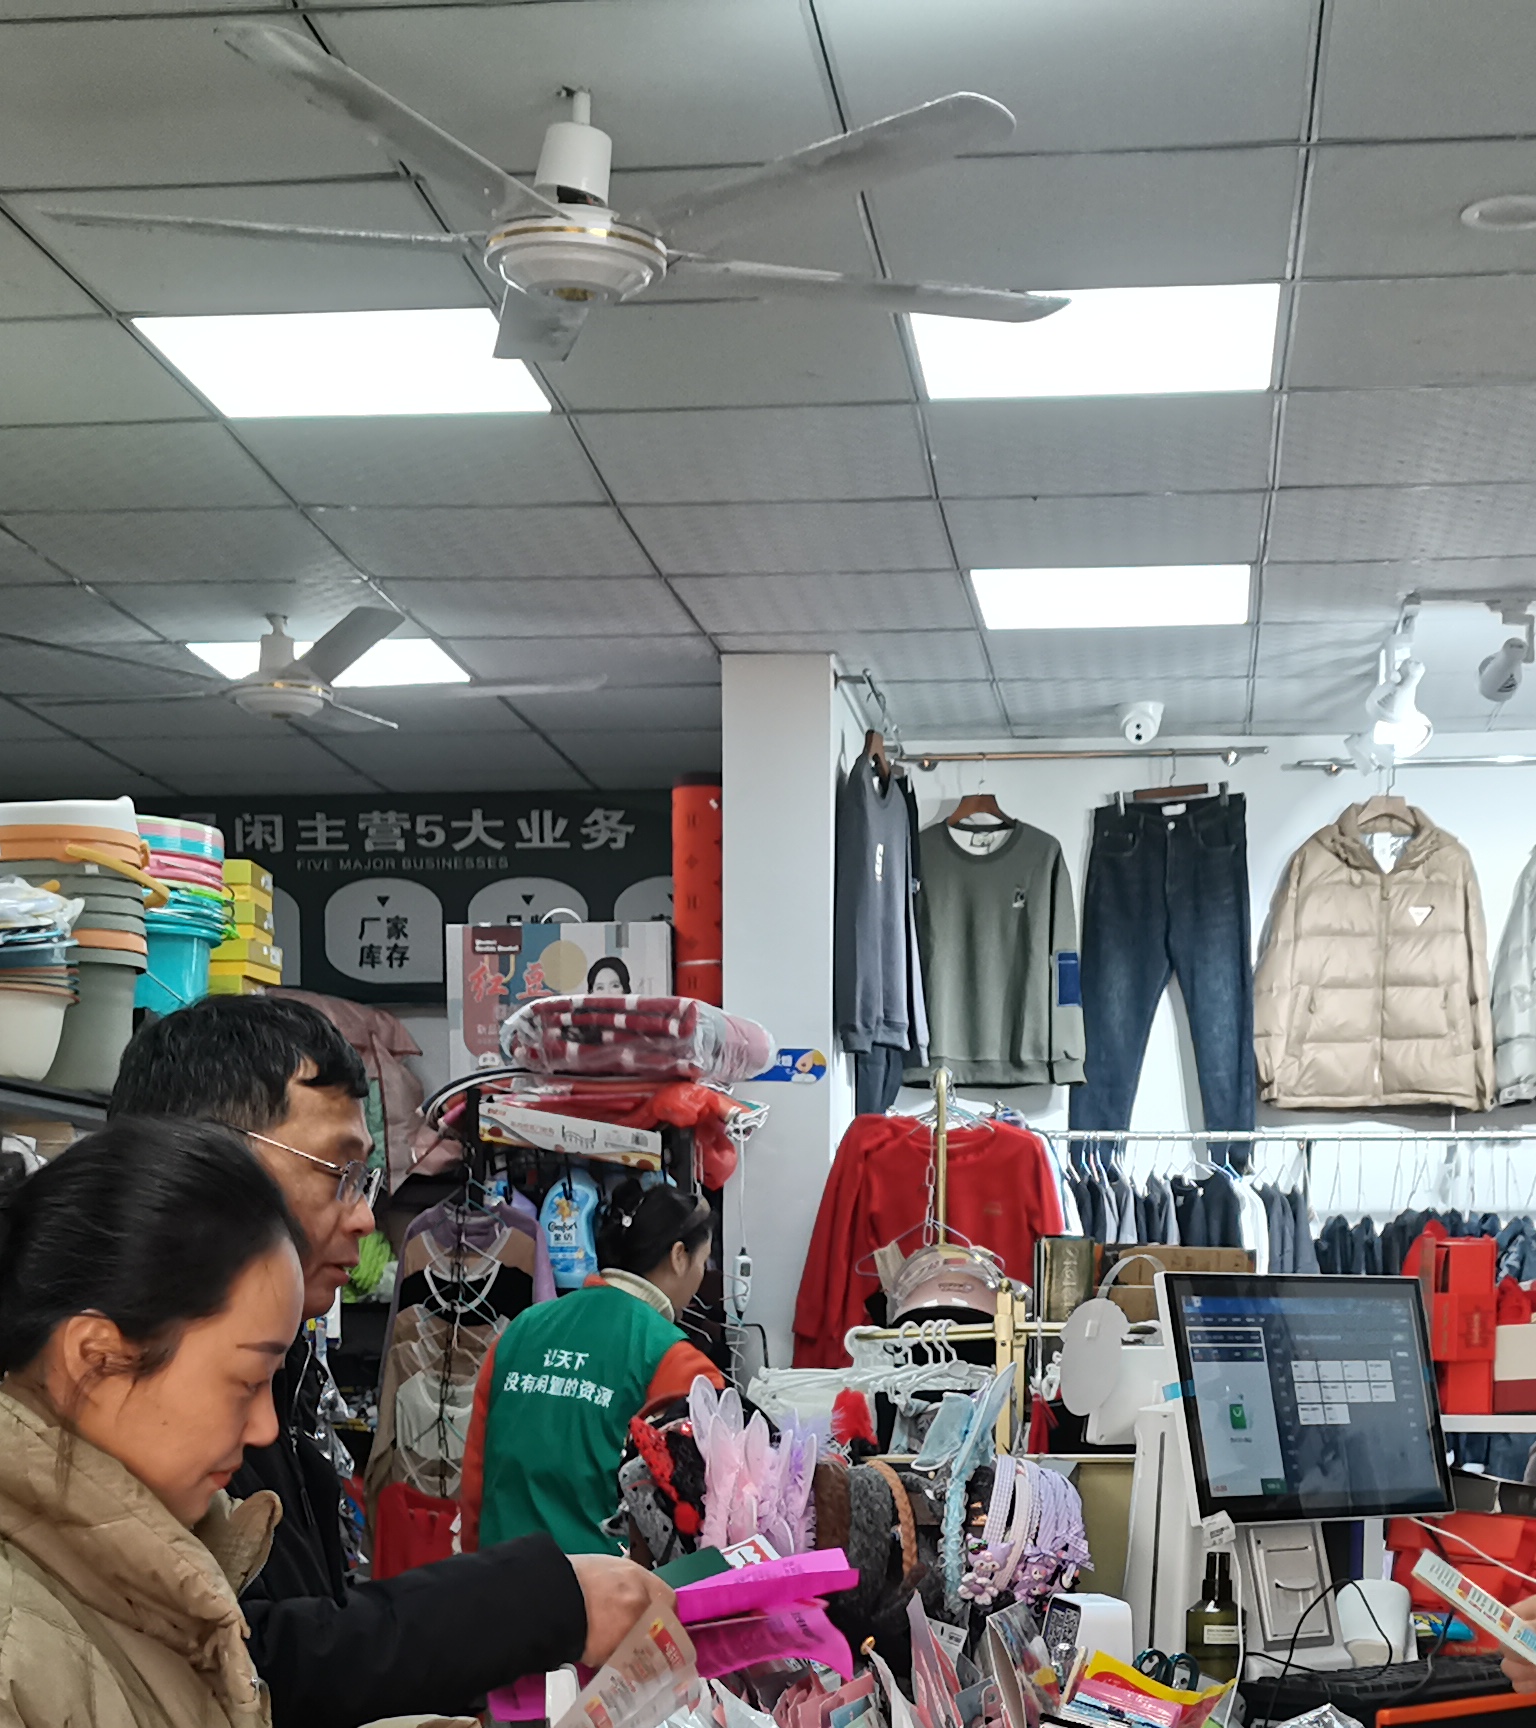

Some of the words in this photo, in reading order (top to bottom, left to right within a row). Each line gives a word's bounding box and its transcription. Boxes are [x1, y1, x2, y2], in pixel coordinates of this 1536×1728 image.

[180, 807, 636, 854] 闲主营5大业务
[296, 859, 331, 872] FIVE
[339, 858, 396, 871] MAJOR
[402, 857, 509, 871] BUSINESSES
[358, 915, 409, 939] 厂家
[358, 944, 410, 969] 库存
[468, 962, 556, 1001] 红豆
[543, 1348, 590, 1372] 让天下
[503, 1371, 615, 1408] 没有闲置的资源
